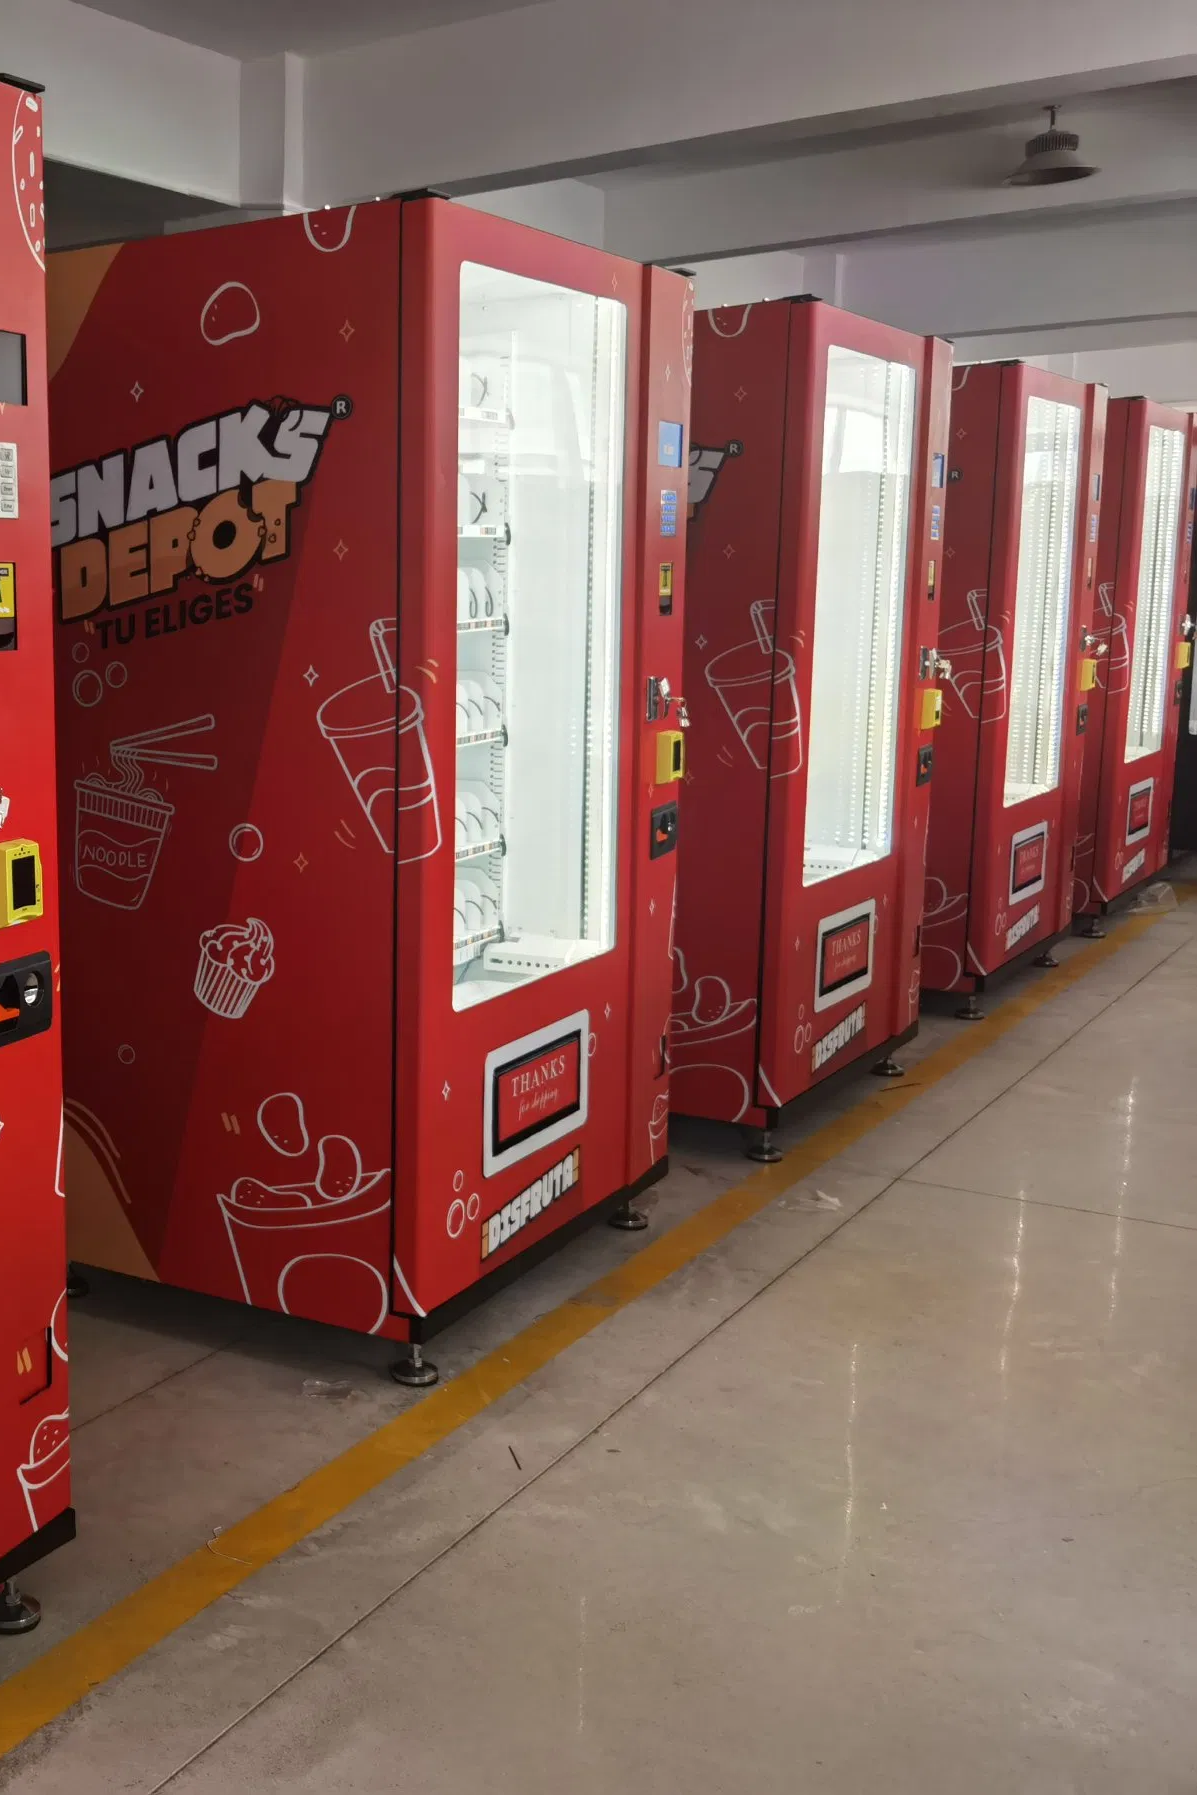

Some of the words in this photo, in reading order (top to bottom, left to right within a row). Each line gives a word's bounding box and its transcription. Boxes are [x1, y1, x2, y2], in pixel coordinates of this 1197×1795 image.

[50, 403, 332, 547] SNACKS
[60, 479, 298, 621] DEPOT
[95, 613, 136, 649] TU
[144, 583, 254, 639] ELIGES
[82, 844, 148, 868] NOODLE
[511, 1055, 566, 1098] THANKS
